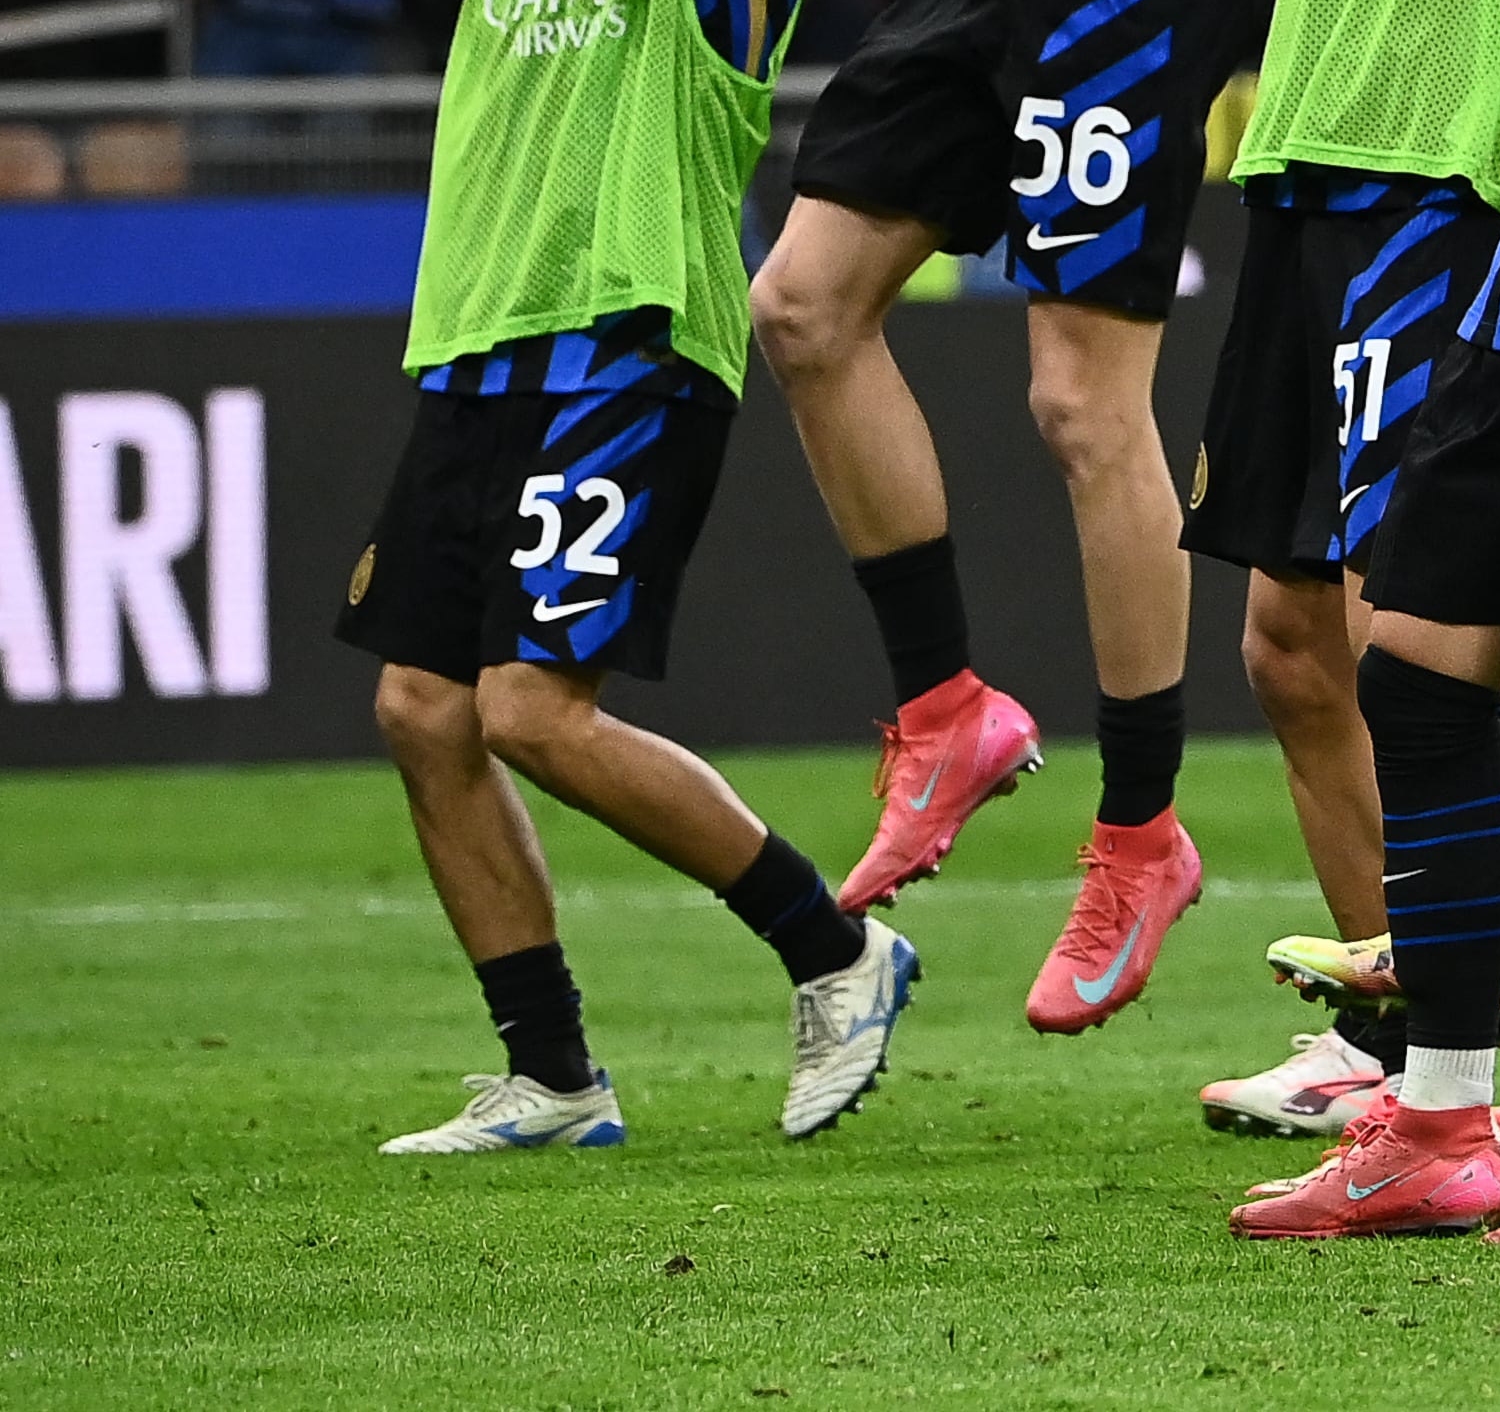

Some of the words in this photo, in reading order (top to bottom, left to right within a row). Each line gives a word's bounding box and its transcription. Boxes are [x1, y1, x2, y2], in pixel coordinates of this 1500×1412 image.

[1010, 96, 1131, 206] 56
[1333, 338, 1392, 446] 51
[510, 473, 626, 577] 52
